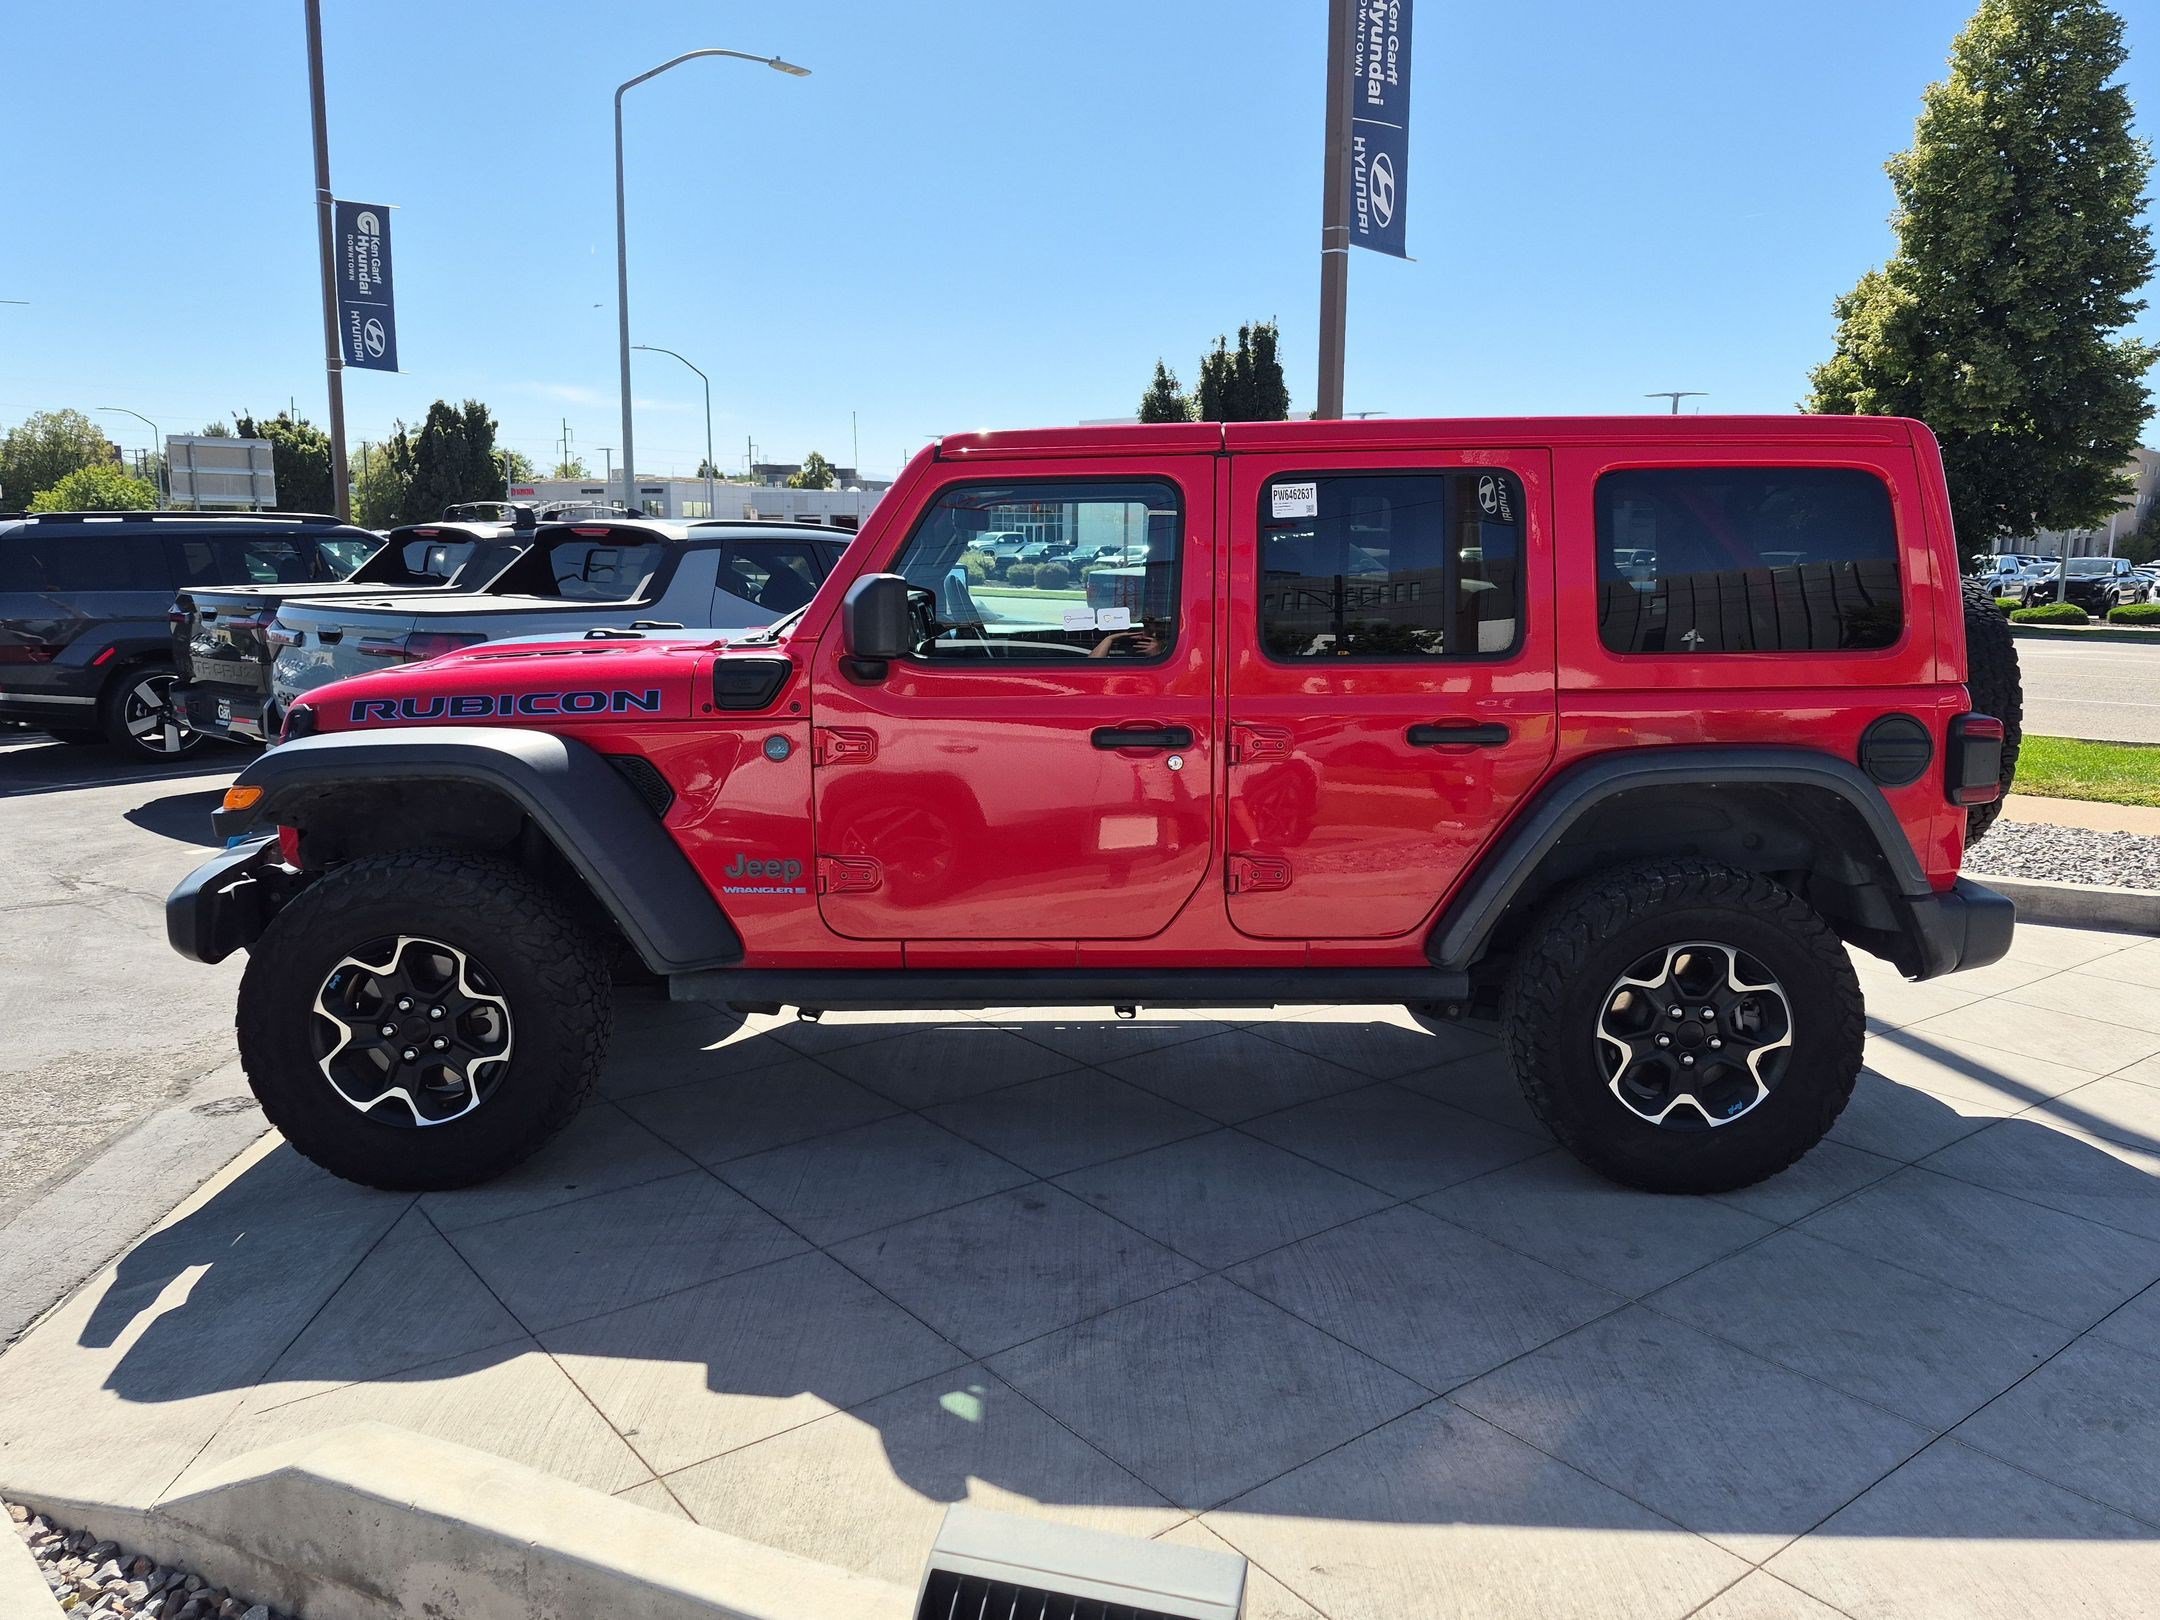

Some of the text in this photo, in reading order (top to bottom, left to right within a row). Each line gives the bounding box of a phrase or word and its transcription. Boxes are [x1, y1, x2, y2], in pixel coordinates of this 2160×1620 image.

[1368, 0, 1387, 105] Hyundai
[1387, 0, 1400, 86] Ken Garff
[1354, 137, 1369, 234] HYUNDAI
[347, 234, 355, 280] DOWNTOWN
[355, 235, 372, 295] Hyundai
[370, 236, 382, 284] Ken Garff
[350, 310, 365, 361] HYUNDAI
[1273, 487, 1313, 501] PW646263T
[350, 689, 662, 722] RUBICON
[722, 886, 794, 894] WRANGLER
[725, 853, 802, 883] Jeep
